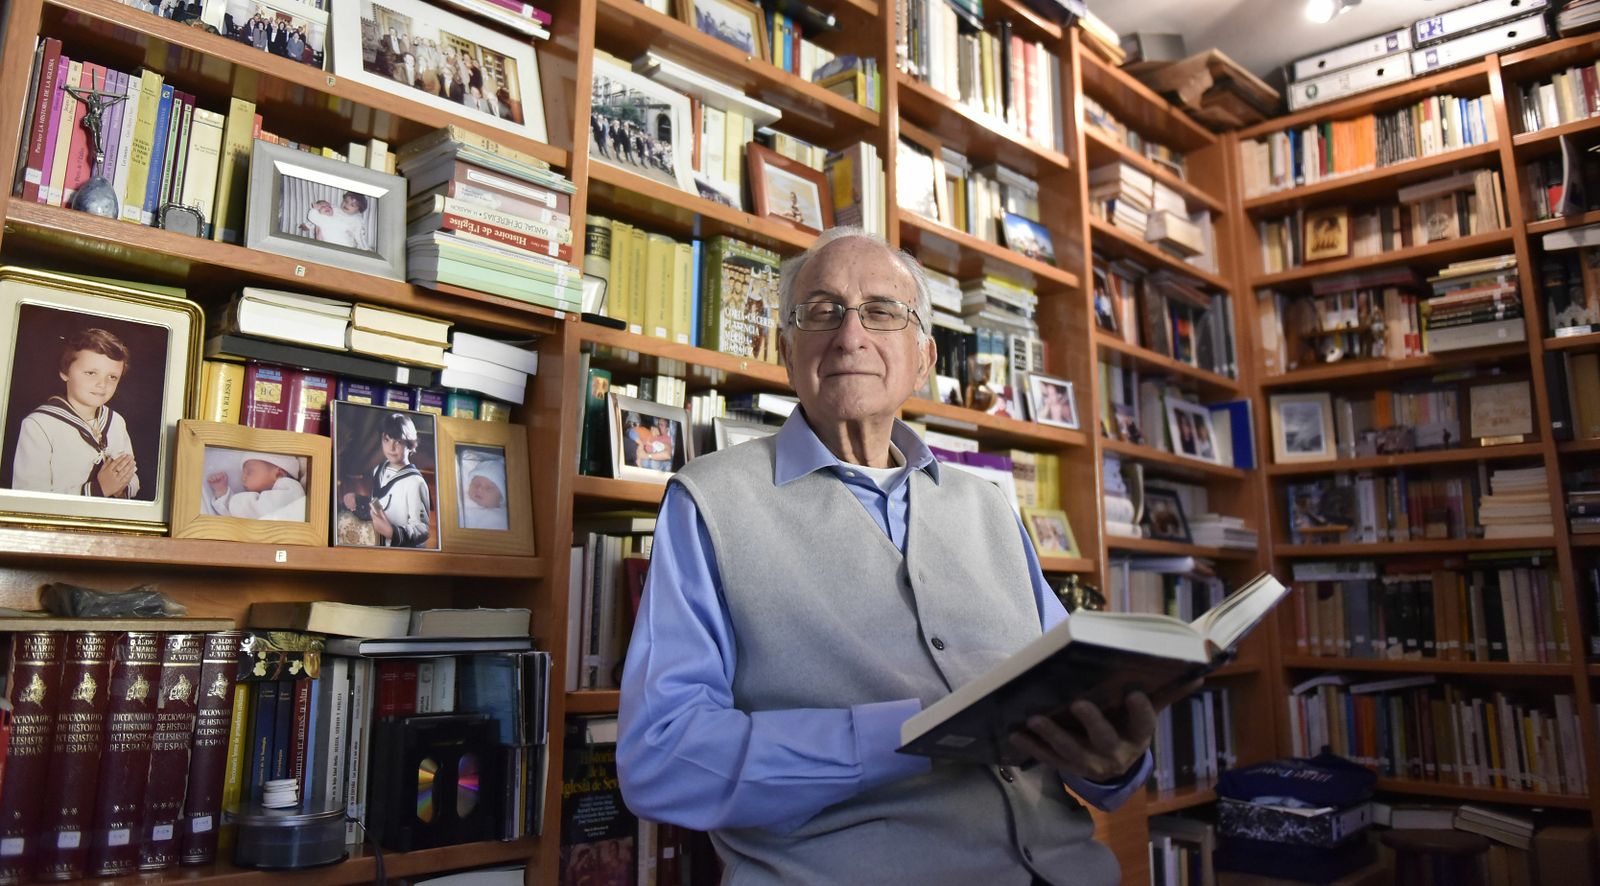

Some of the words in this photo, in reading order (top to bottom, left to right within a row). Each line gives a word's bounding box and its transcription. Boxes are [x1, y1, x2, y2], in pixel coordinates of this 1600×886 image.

[45, 80, 51, 88] LA
[43, 89, 49, 97] DE
[39, 97, 48, 123] HISTORIA
[38, 124, 44, 132] LA
[447, 215, 481, 236] l'Église
[512, 220, 523, 228] DE
[480, 226, 492, 236] de
[493, 229, 527, 245] Histoire
[221, 408, 228, 417] LA
[68, 722, 101, 733] HISTORIA
